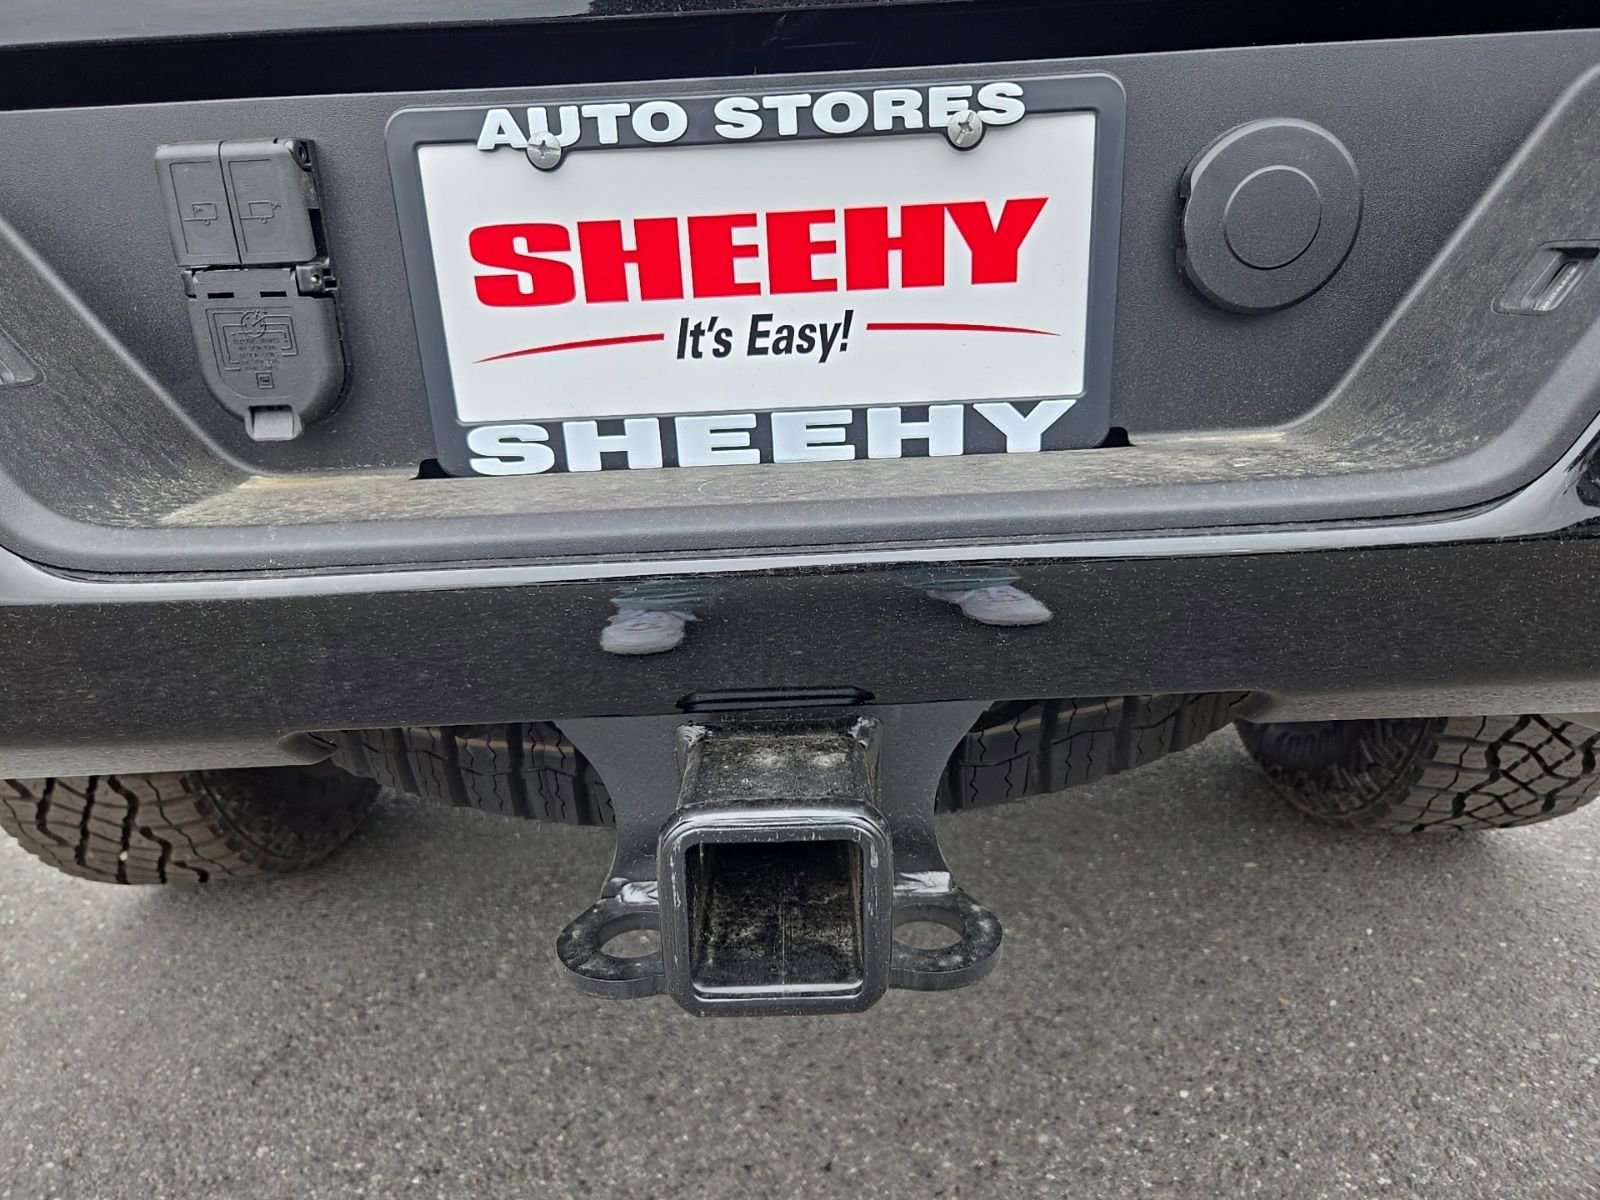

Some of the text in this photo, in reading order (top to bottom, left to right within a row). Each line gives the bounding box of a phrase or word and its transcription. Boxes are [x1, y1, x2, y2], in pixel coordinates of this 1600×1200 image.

[477, 82, 1025, 150] AUTO STORES
[469, 197, 1048, 308] SHEEHY
[677, 309, 854, 364] It's Easy!
[467, 398, 1077, 476] SHEEHY
